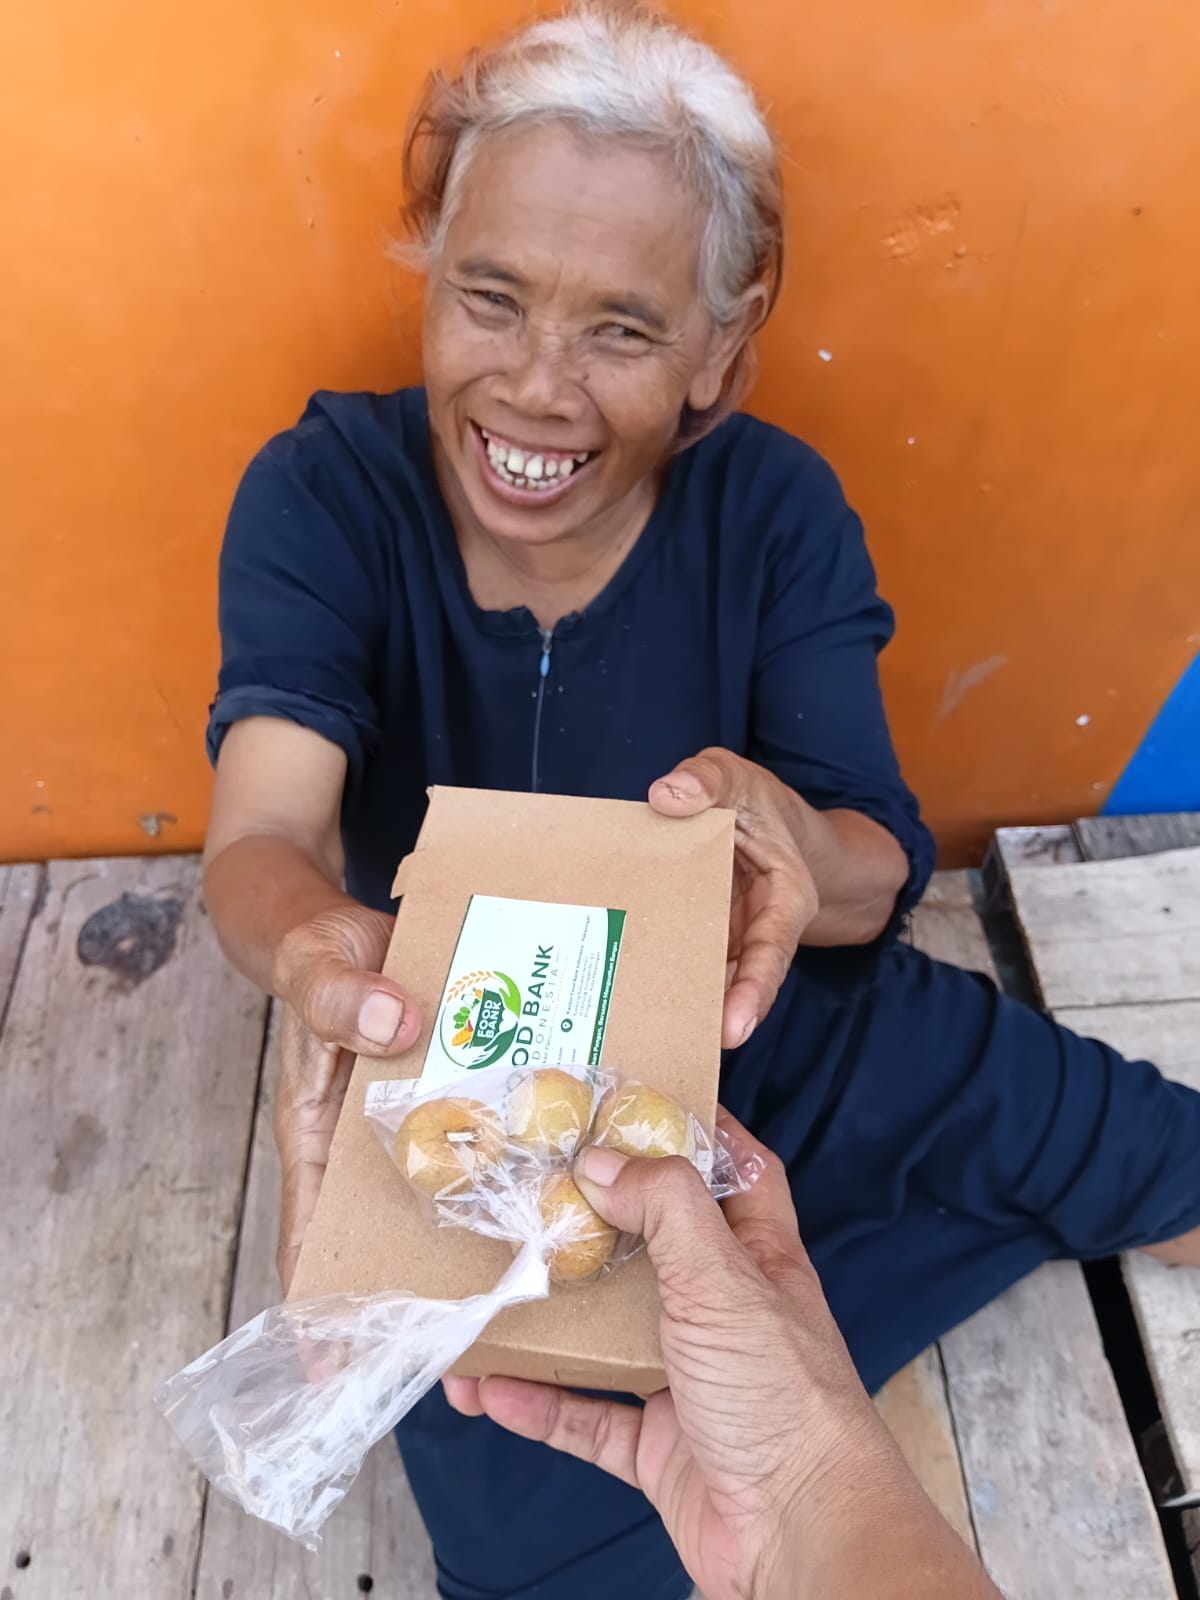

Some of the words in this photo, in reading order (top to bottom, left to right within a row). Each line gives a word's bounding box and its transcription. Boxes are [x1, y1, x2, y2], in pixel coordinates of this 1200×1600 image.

[522, 944, 553, 1016] BANK
[477, 1000, 493, 1037] FOOD
[485, 1001, 502, 1038] BANK
[532, 968, 558, 1059] DONESIA
